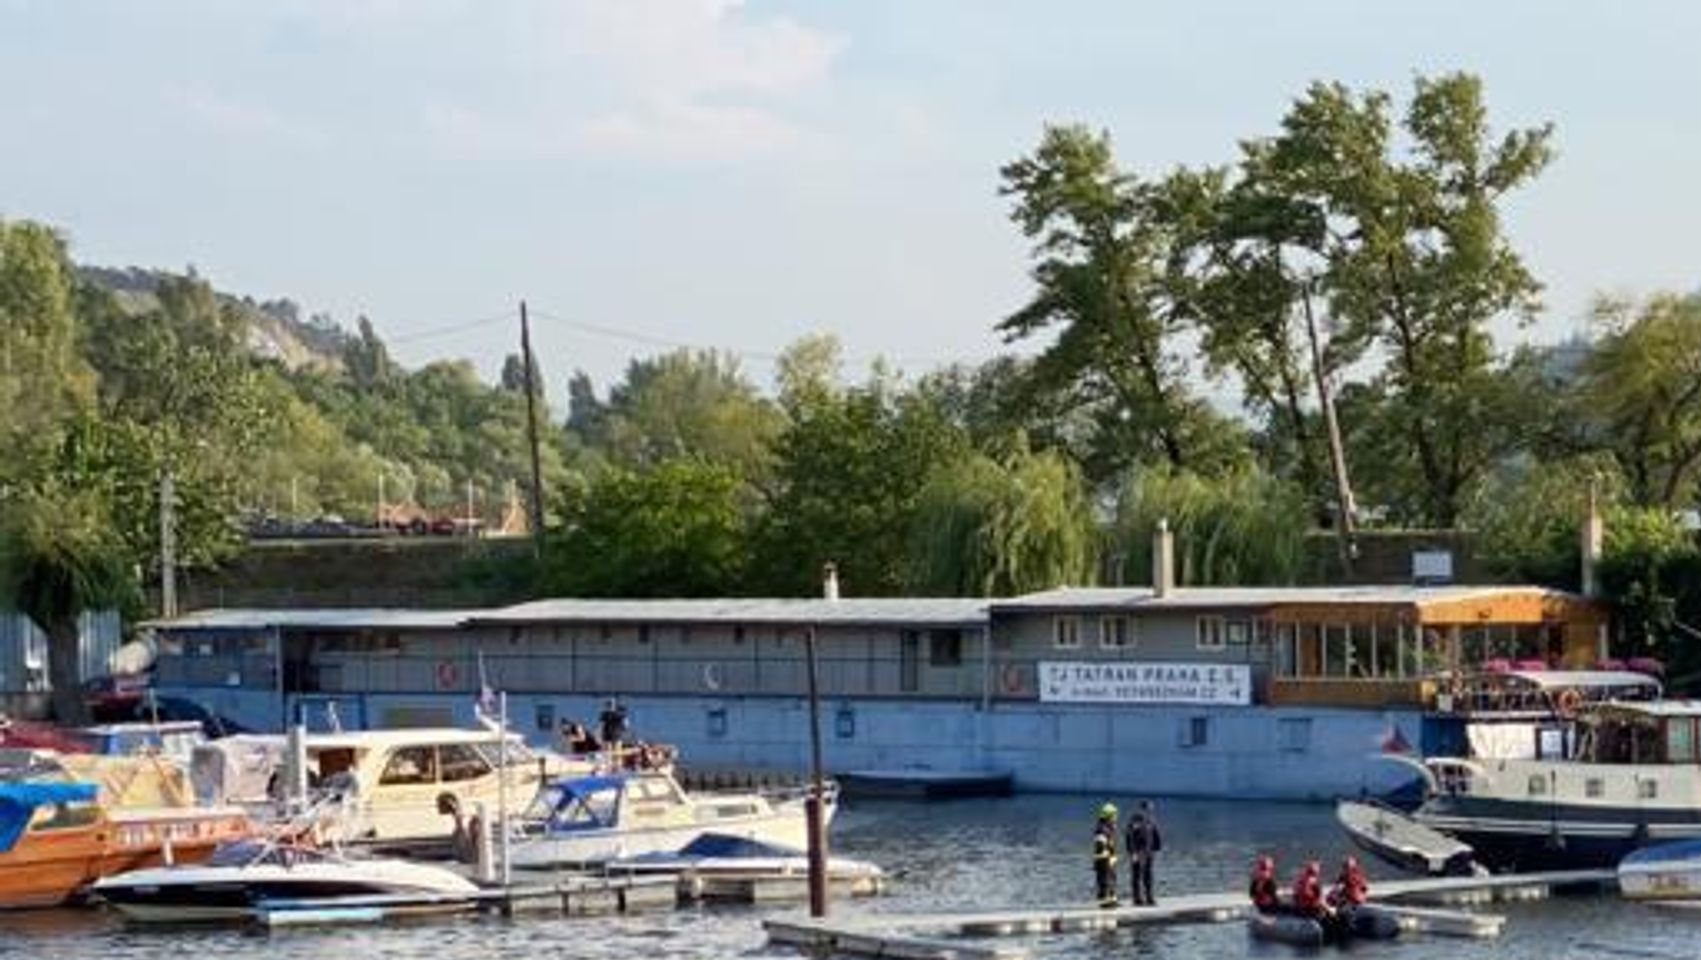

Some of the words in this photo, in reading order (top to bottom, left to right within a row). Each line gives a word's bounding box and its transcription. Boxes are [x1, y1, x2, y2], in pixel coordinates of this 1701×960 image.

[1049, 667, 1068, 682] TJ
[1074, 667, 1138, 682] TATRAN
[1143, 667, 1200, 682] PRAHA
